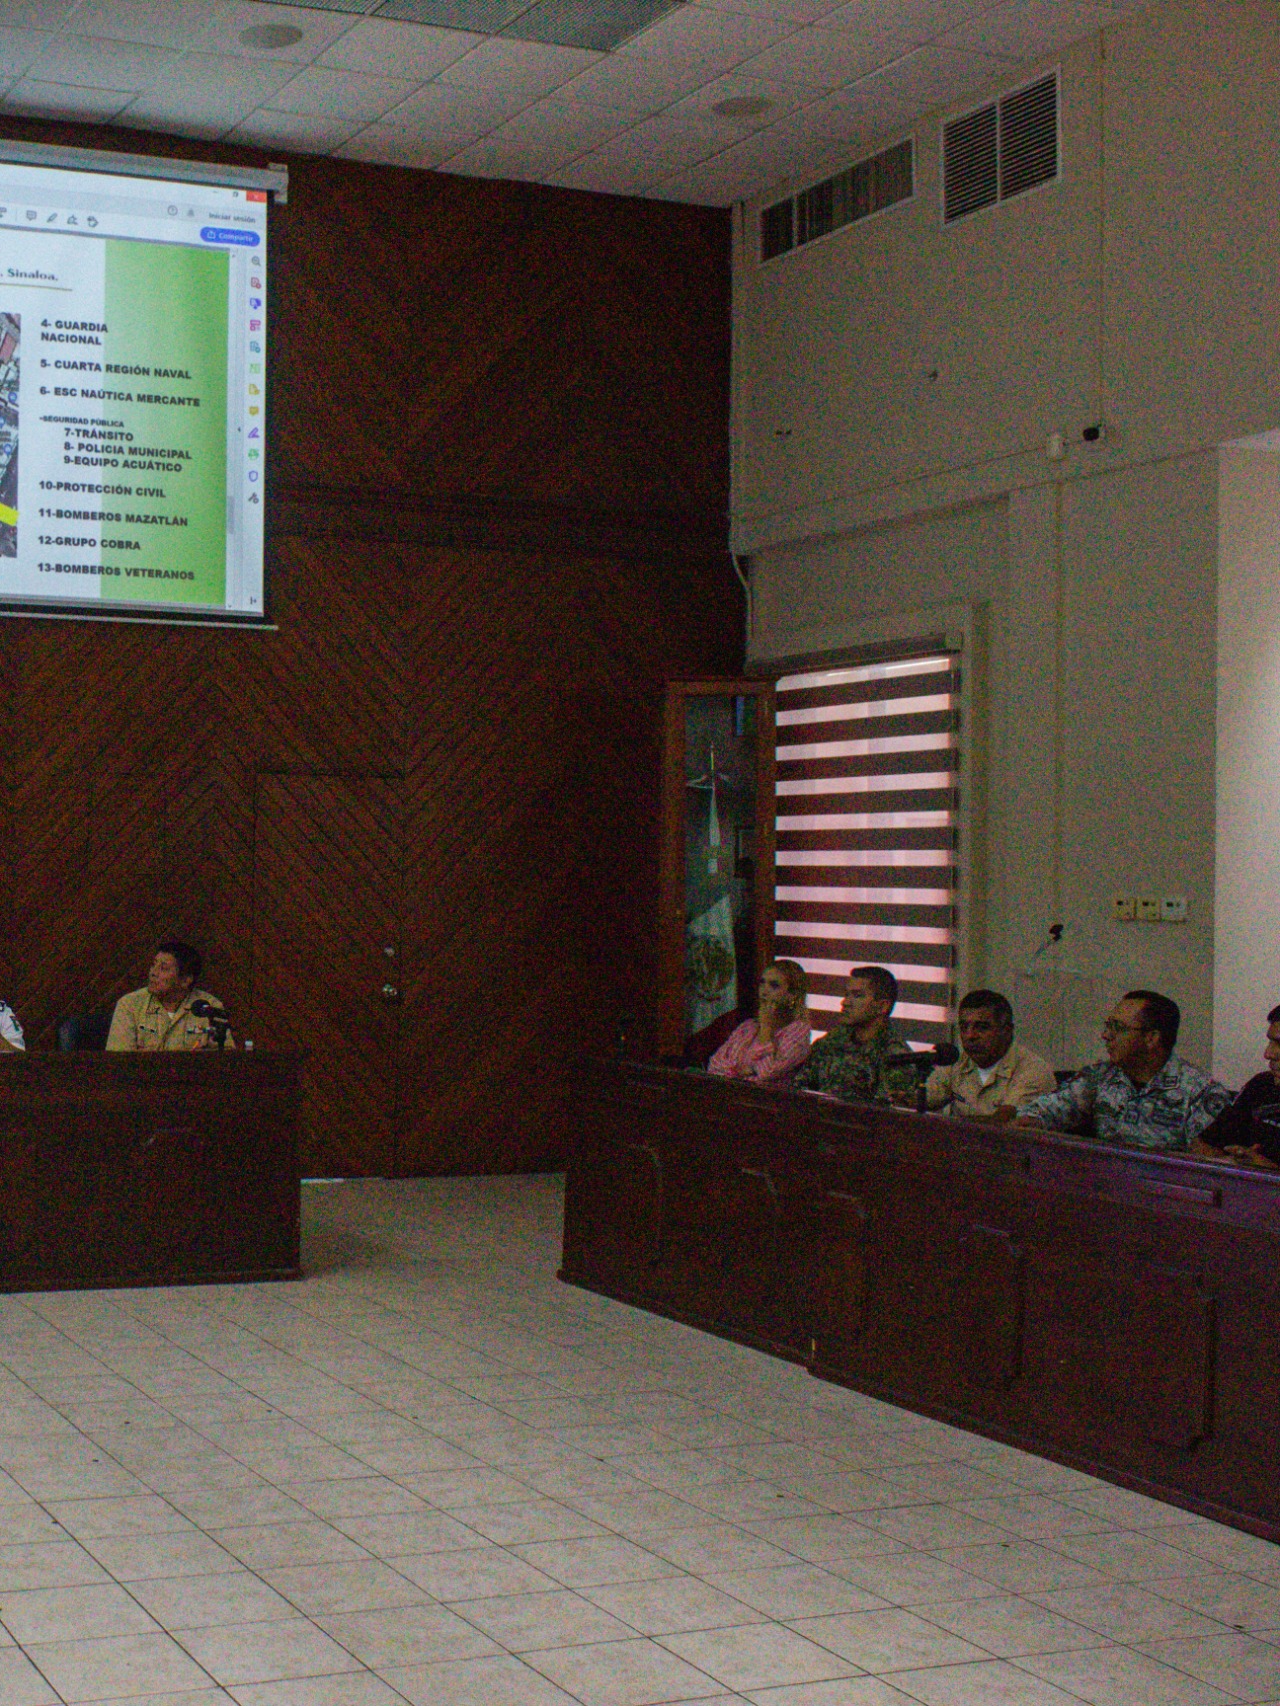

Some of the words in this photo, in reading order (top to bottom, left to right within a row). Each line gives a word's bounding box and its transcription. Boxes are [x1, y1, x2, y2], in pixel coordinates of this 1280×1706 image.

[219, 232, 253, 243] Compartir
[41, 319, 51, 328] 4-
[55, 320, 108, 333] GUARDIA
[41, 332, 102, 346] NACIONAL
[40, 359, 51, 368] 5-
[54, 360, 102, 372] CUARTA
[105, 363, 150, 376] REGIÓN
[154, 368, 192, 379] NAVAL
[40, 386, 50, 395] 6-
[54, 387, 77, 397] ESC
[81, 388, 133, 401] NAÚTICA
[136, 394, 200, 407] MERCANTE
[90, 418, 124, 428] PÚBLICA
[64, 428, 133, 442] 7-TRÁNSITO
[64, 442, 74, 451] 8-
[78, 443, 125, 455] POLICIA
[128, 446, 192, 460] MUNICIPAL
[64, 456, 118, 468] 9-EQUIPO
[122, 460, 183, 472] ACUÁTICO
[39, 480, 132, 496] 10-PROTECCIÓN
[135, 487, 166, 498] CIVIL
[38, 508, 121, 522] 11-BOMBEROS
[125, 513, 188, 527] MAZATLÁN
[38, 535, 96, 548] 12-GRUPO
[101, 539, 140, 550] COBRA
[37, 563, 121, 576] 13-BOMBEROS
[125, 567, 195, 581] VETERANOS
